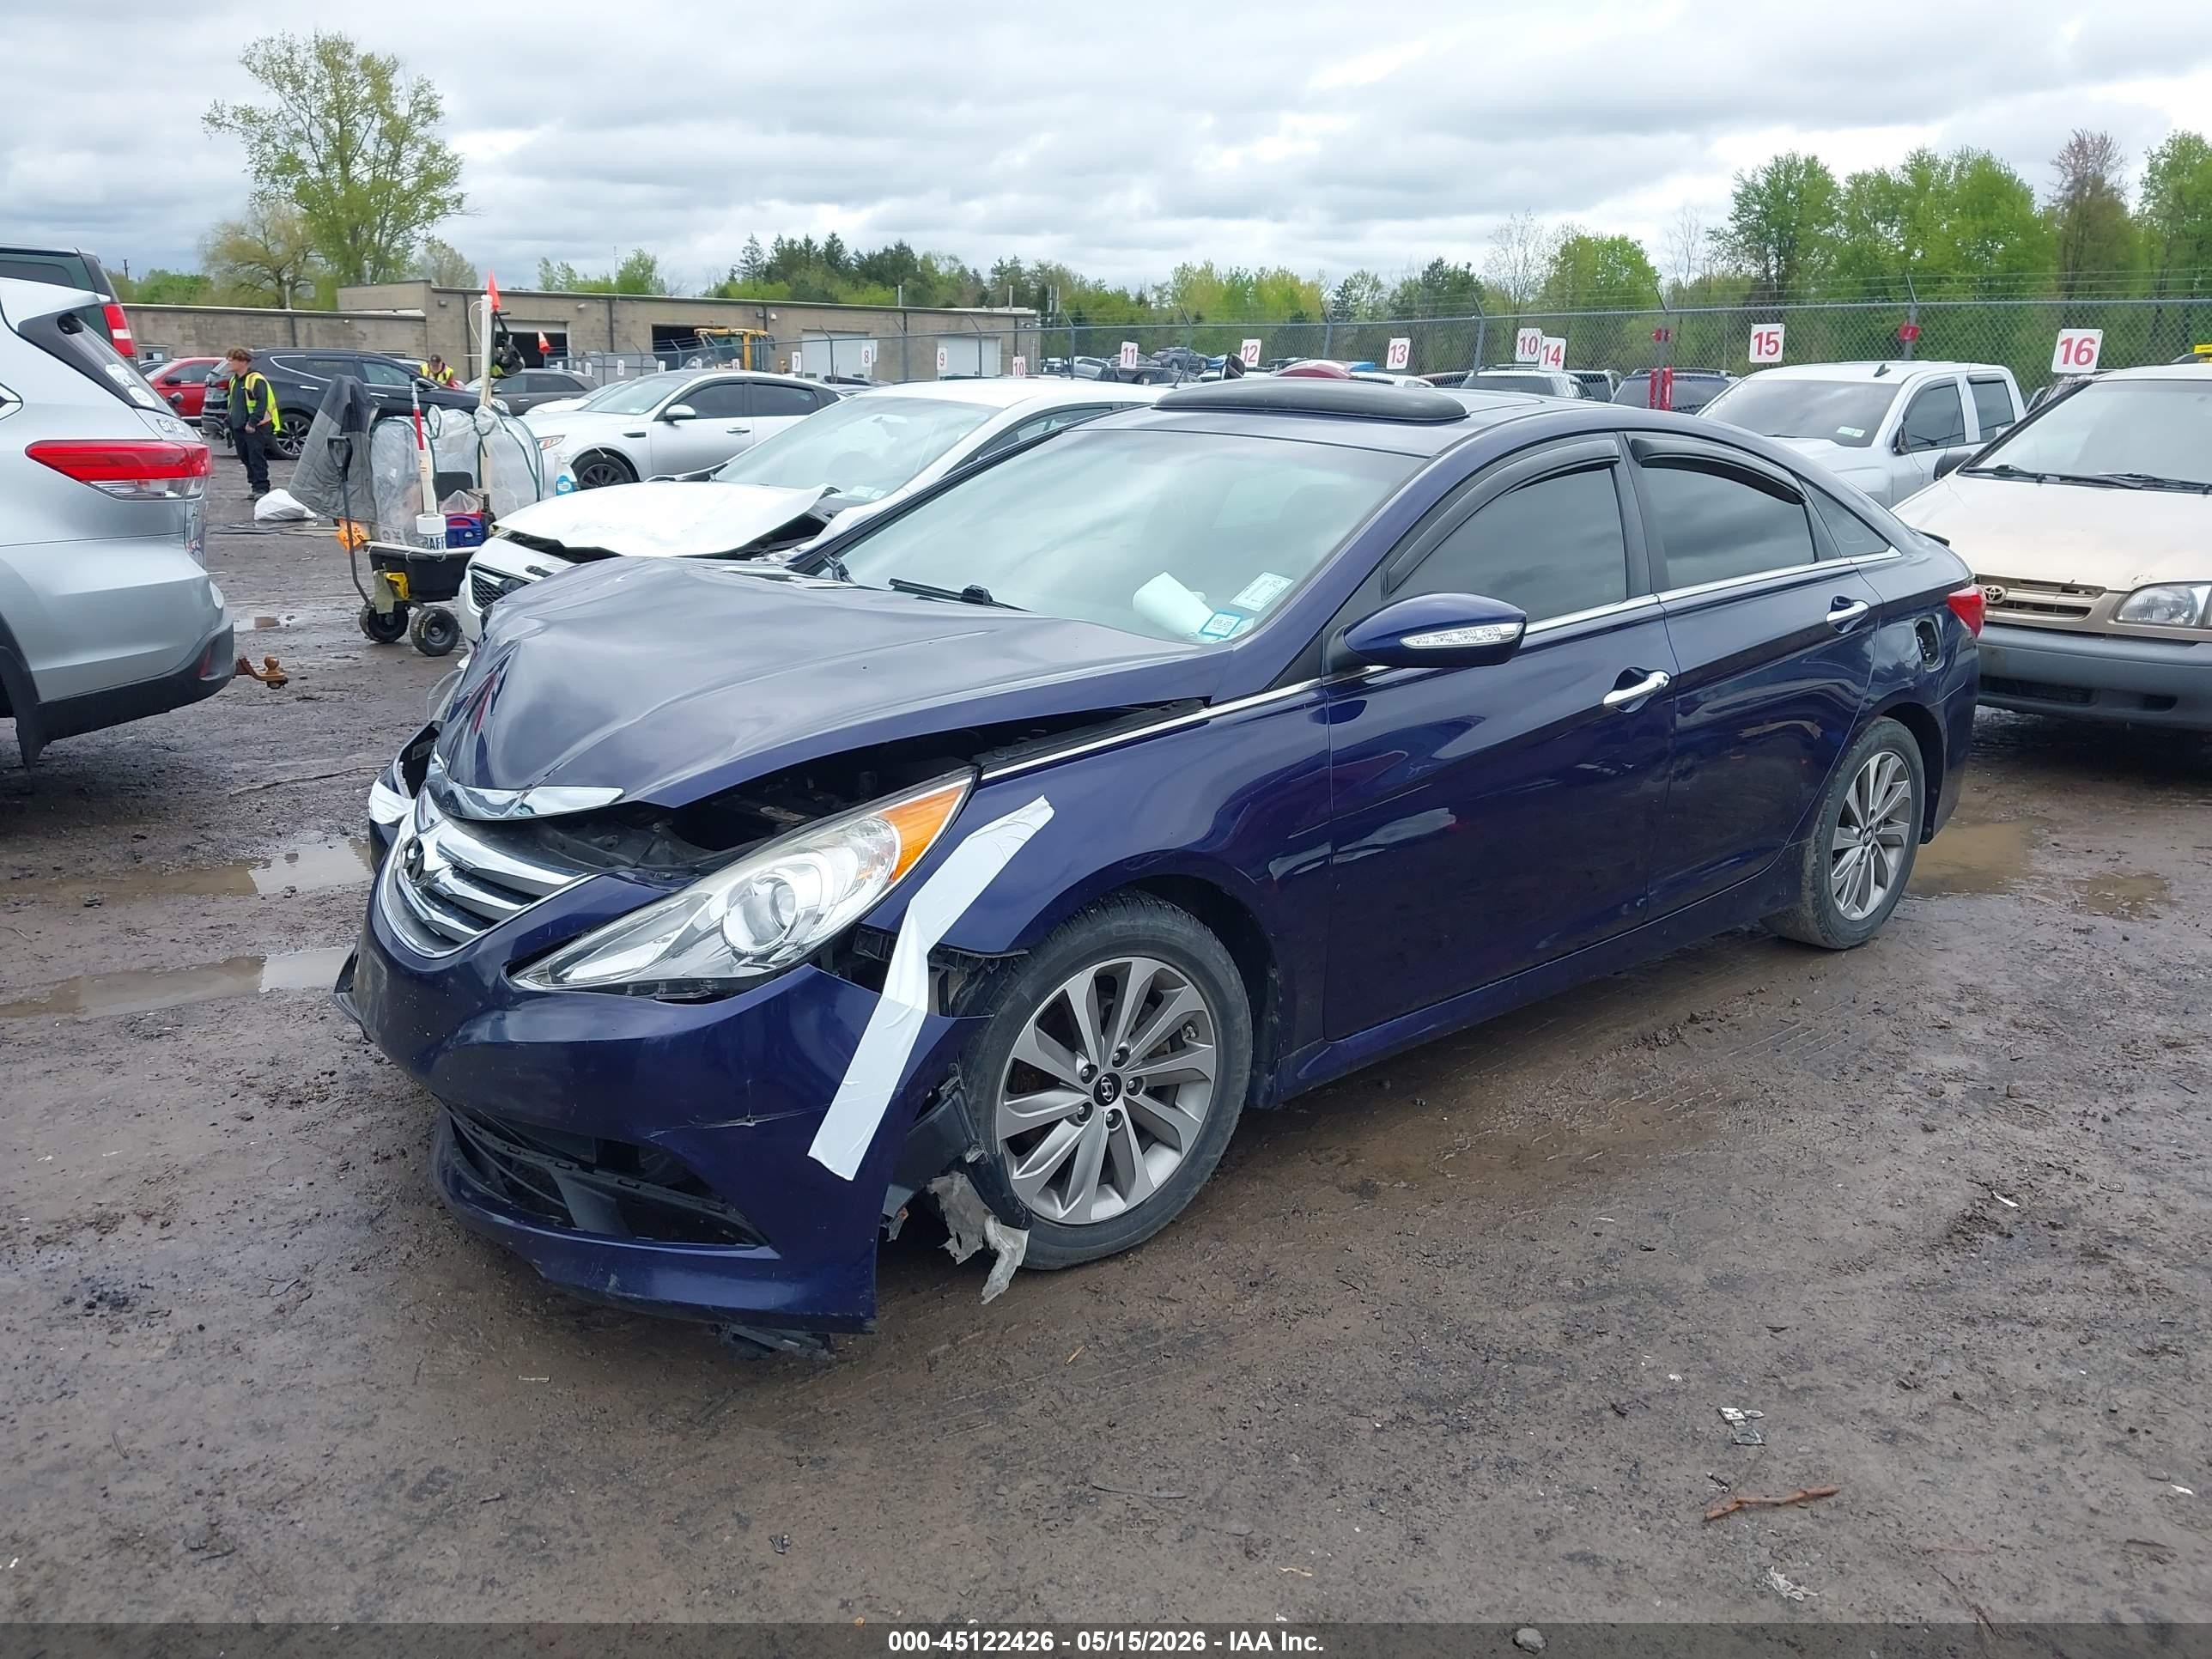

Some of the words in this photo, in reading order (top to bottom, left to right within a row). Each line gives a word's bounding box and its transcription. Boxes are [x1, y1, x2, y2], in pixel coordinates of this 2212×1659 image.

[1520, 336, 1538, 356] 10
[1753, 331, 1780, 356] 15
[2060, 337, 2096, 366] 16
[794, 355, 799, 368] 7
[864, 349, 869, 364] 8
[939, 352, 945, 367] 9
[1123, 347, 1135, 365] 11
[1243, 344, 1258, 362] 12
[1390, 343, 1407, 364] 13
[1543, 343, 1561, 367] 14
[1014, 362, 1024, 376] 10
